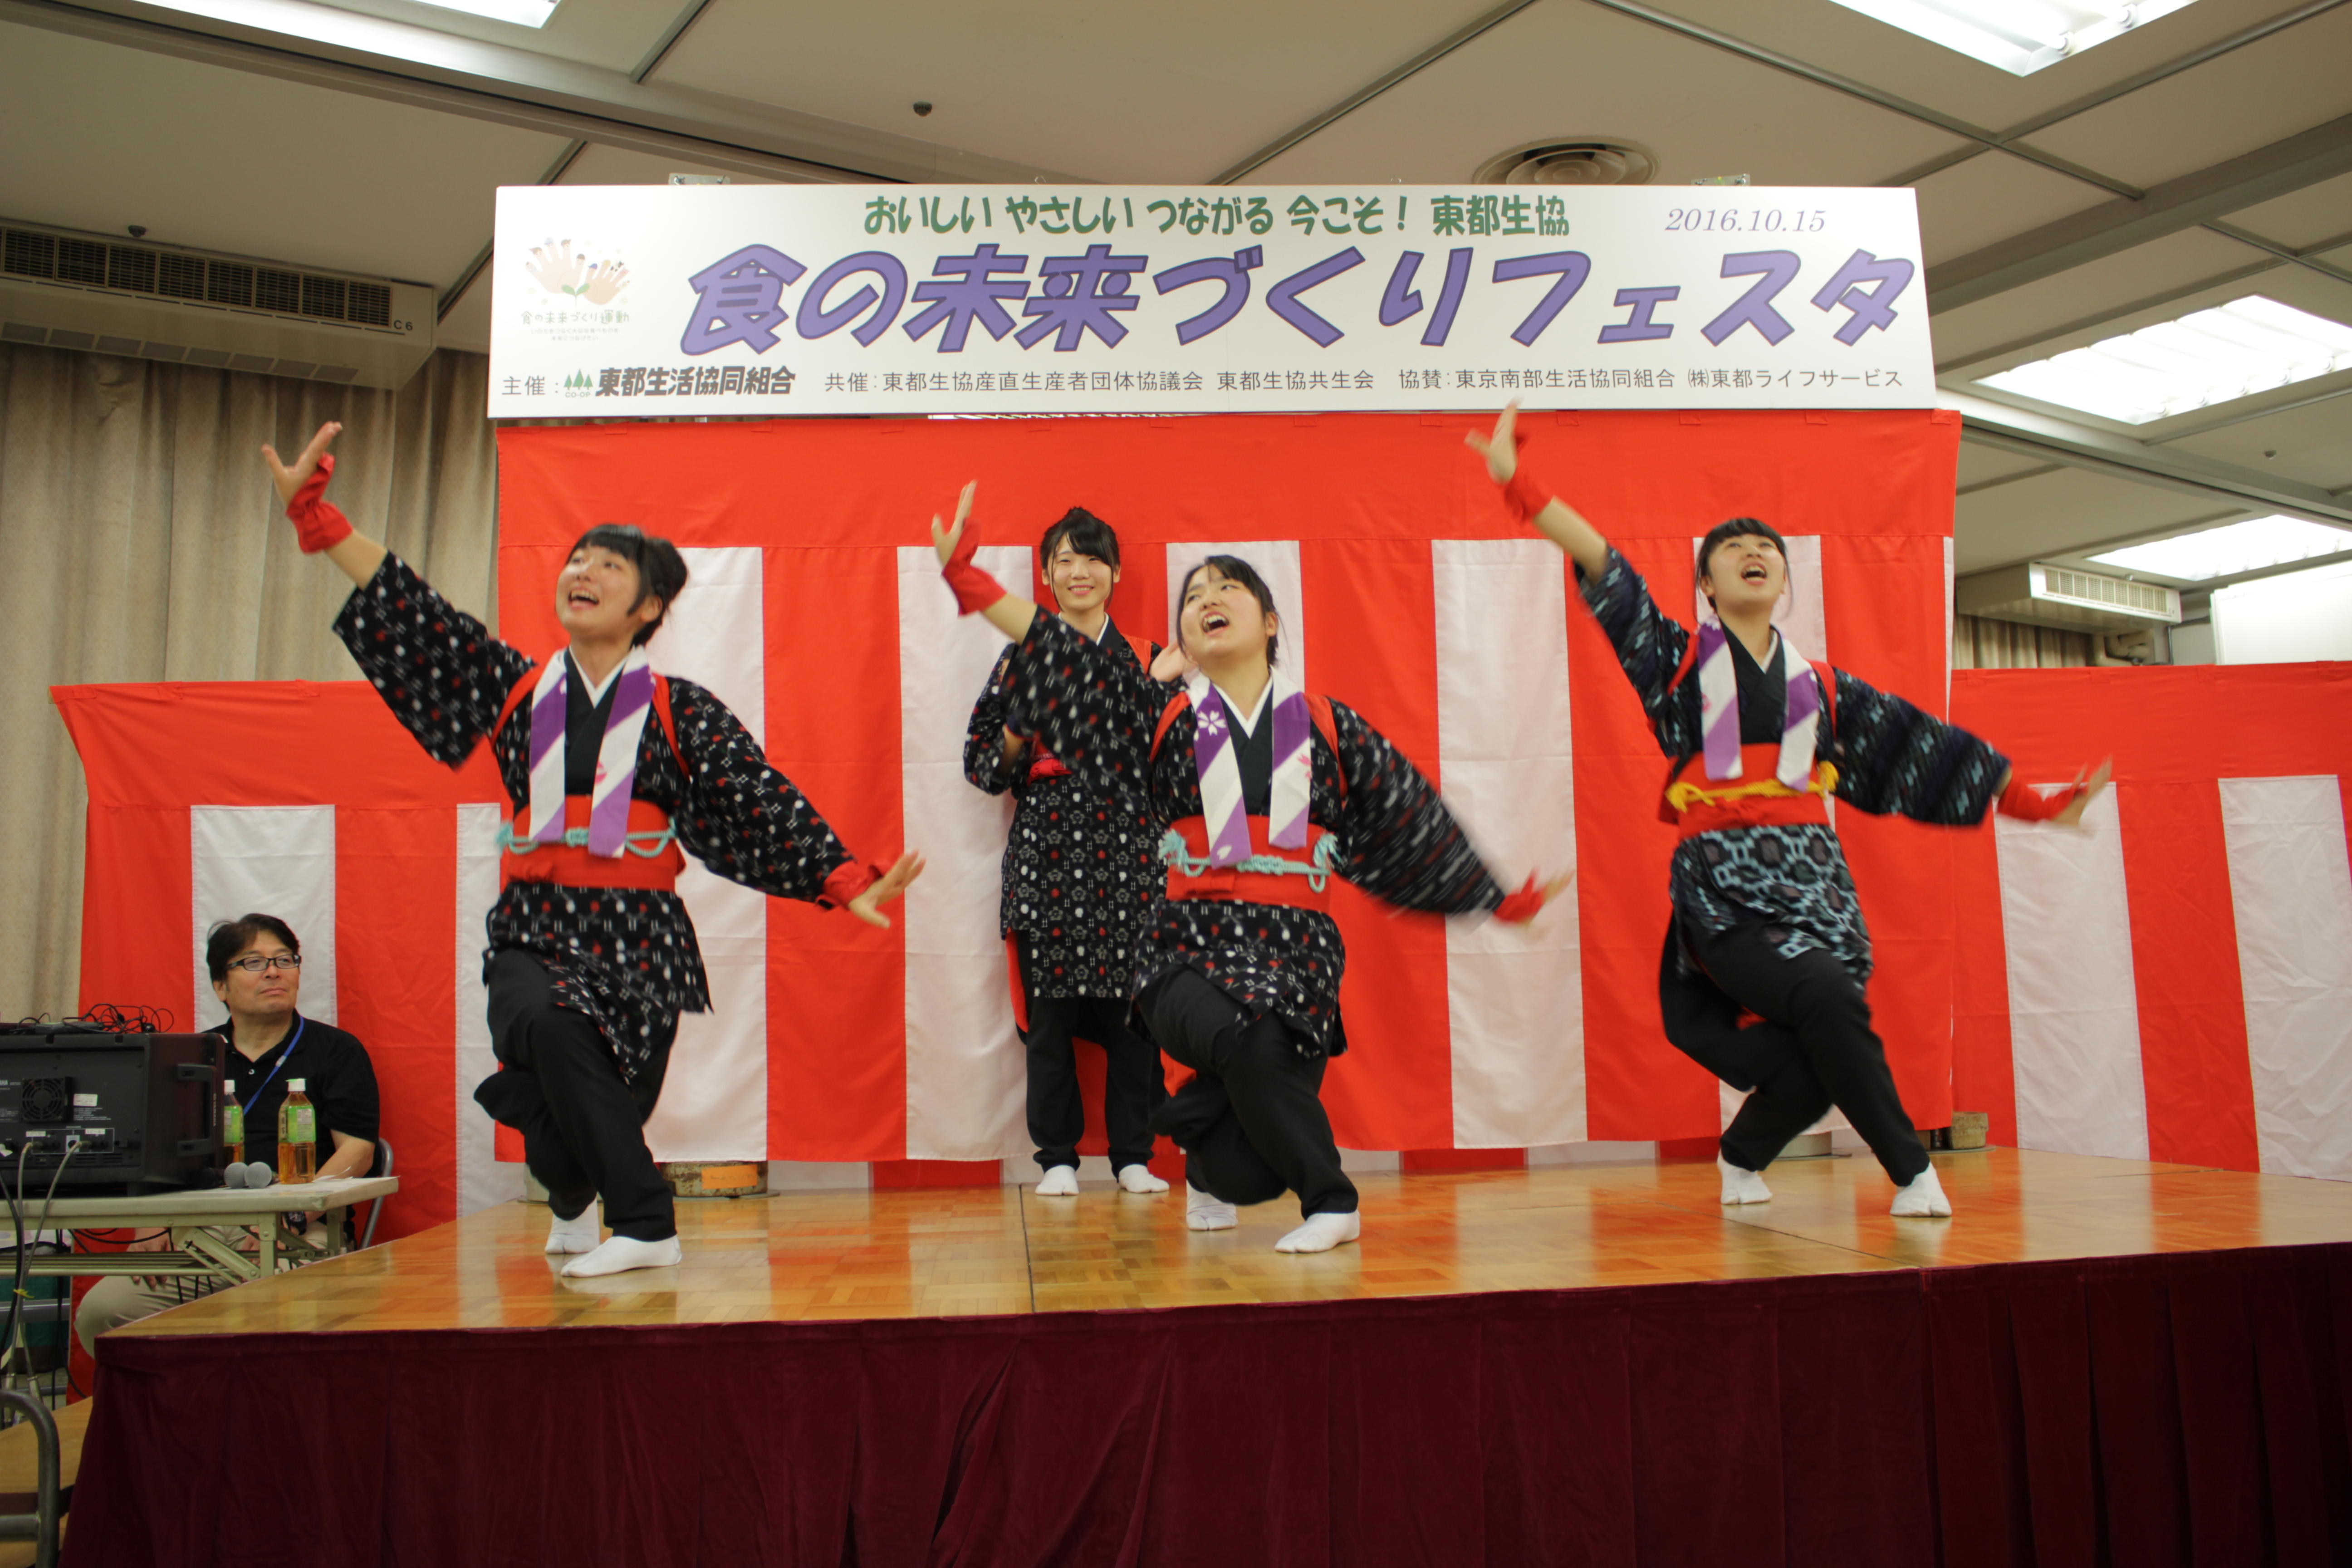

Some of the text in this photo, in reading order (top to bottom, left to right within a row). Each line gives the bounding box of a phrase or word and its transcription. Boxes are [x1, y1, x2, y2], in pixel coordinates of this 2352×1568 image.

[864, 196, 992, 235] おいしい
[1005, 196, 1134, 235] やさしい
[1147, 196, 1274, 235] つながる
[1430, 194, 1570, 237] 東都生協
[1664, 208, 1826, 232] 2016.10.15
[680, 244, 1915, 356] 食の未来づくりフェスタ
[393, 319, 413, 331] C 6
[521, 310, 630, 325] 食の未来づくり運動
[595, 365, 796, 397] 東都生活協同組合
[1217, 370, 1373, 391] 東都生協共生会
